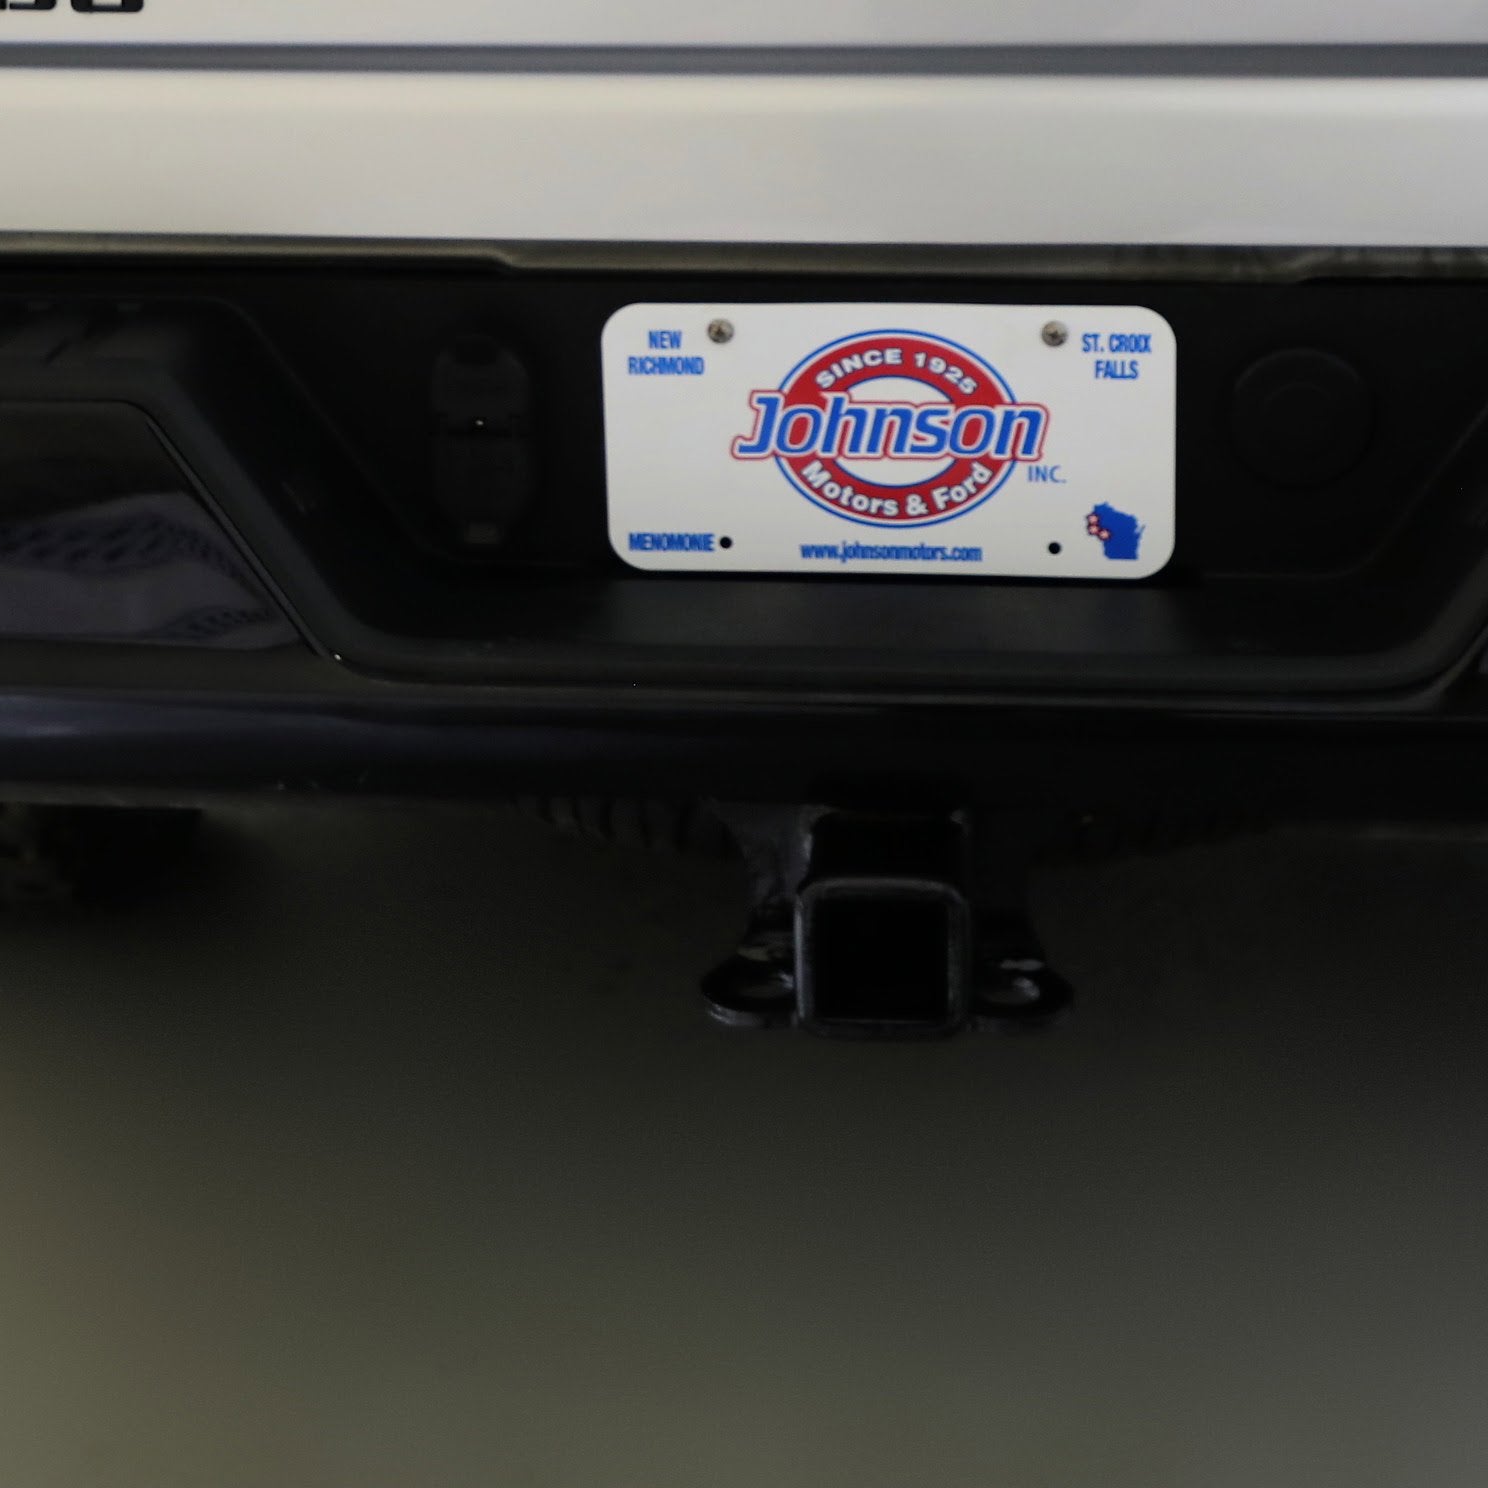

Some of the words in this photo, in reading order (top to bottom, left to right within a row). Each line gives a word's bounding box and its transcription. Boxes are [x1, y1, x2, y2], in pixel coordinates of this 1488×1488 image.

[648, 330, 682, 349] NEW
[1082, 333, 1104, 353] ST.
[1109, 333, 1152, 353] CROIX
[628, 356, 704, 375] RICHMOND
[816, 348, 903, 389] SINCE
[914, 351, 977, 396] 1925
[1095, 359, 1139, 379] FALLS
[731, 388, 1050, 461] Johnson
[1027, 465, 1067, 483] INC.
[801, 461, 898, 517] Motors
[906, 496, 928, 516] &
[933, 464, 991, 510] Ford
[629, 533, 715, 551] MENOMONIE
[800, 541, 983, 563] www.johnsonmotors.com
